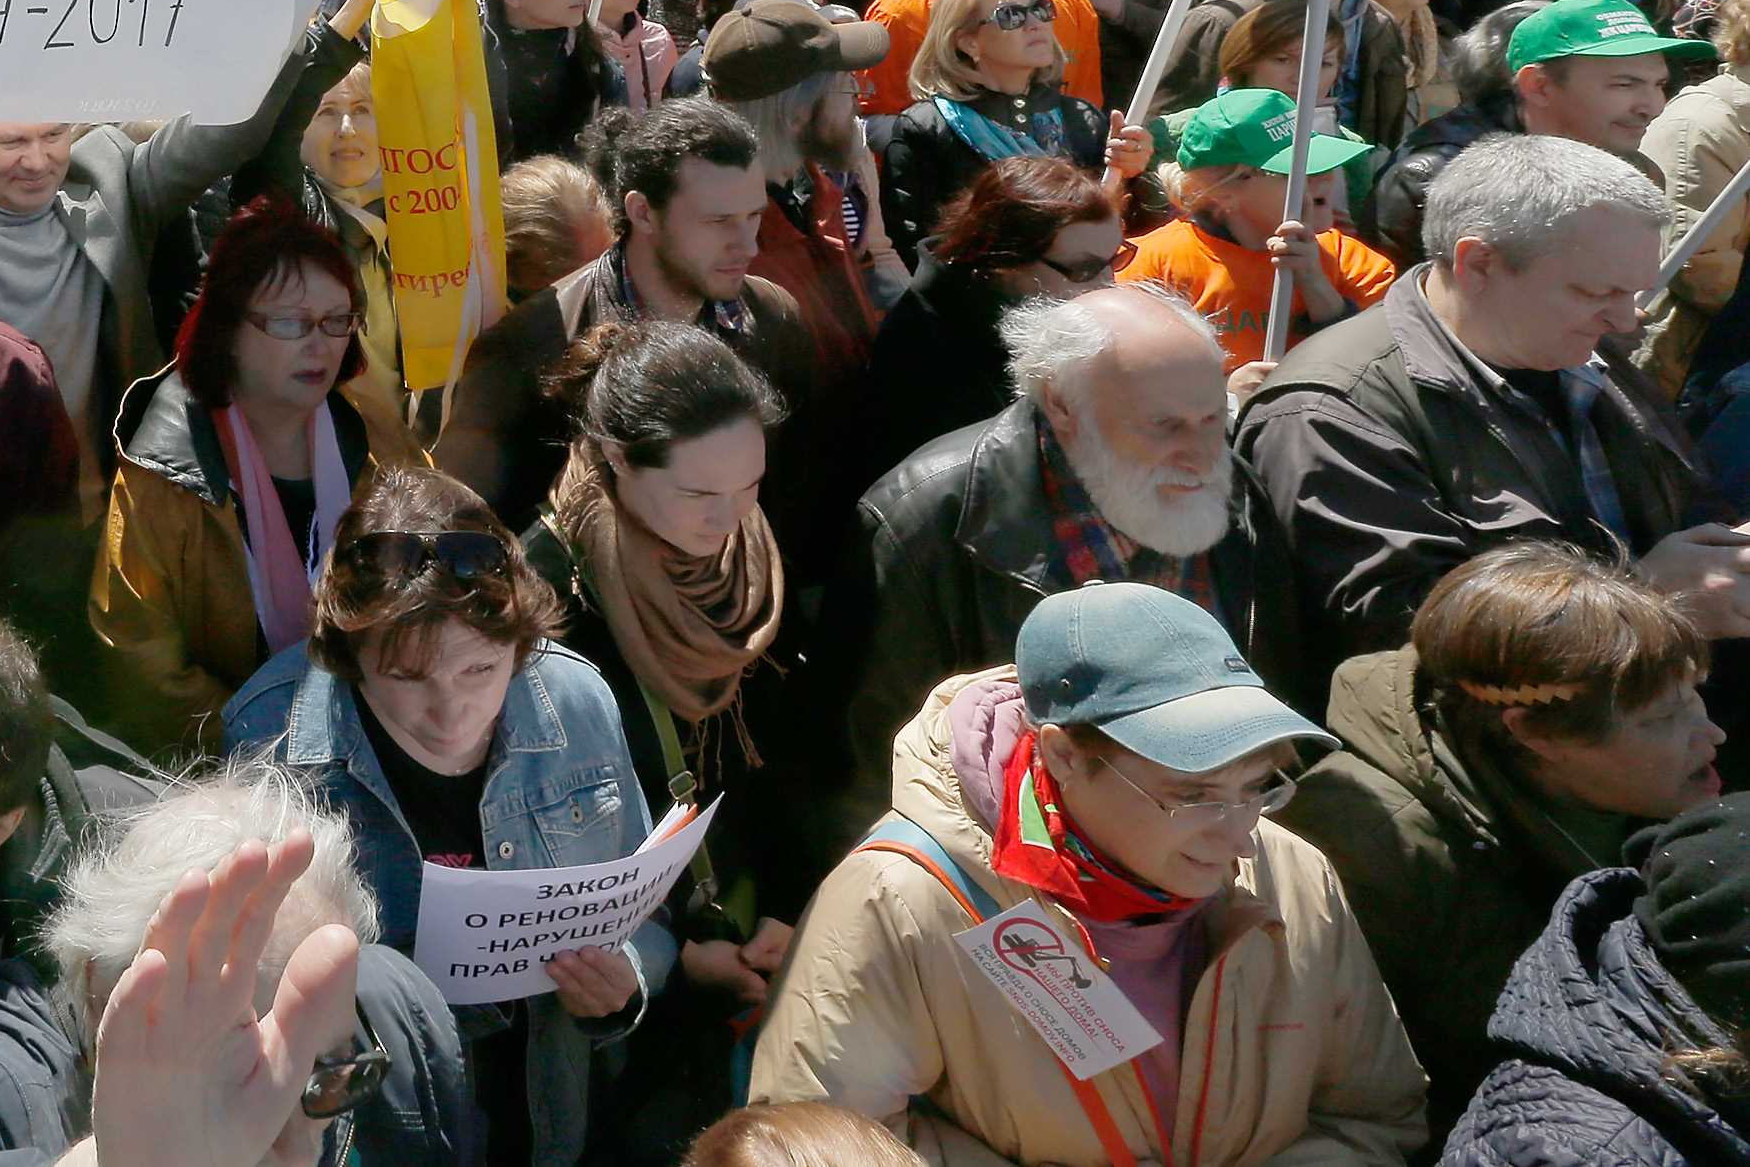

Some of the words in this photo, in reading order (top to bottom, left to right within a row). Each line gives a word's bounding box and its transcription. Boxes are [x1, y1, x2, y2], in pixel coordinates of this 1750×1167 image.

[407, 187, 461, 215] 200
[464, 913, 489, 929] О
[498, 865, 673, 928] РЕНОВАЦИИ
[535, 866, 641, 901] ЗАКОН
[449, 958, 530, 978] ПРАВ
[970, 947, 985, 963] НА
[982, 959, 1008, 989] САЙТЕ
[1032, 966, 1072, 1010] НАШЕГО
[1065, 1002, 1101, 1041] ДОМА!
[1044, 961, 1063, 980] МЫ
[1058, 975, 1097, 1021] ПРОТИВ
[1093, 1016, 1127, 1054] СНОСА
[1052, 1022, 1087, 1062] ДОМОВ
